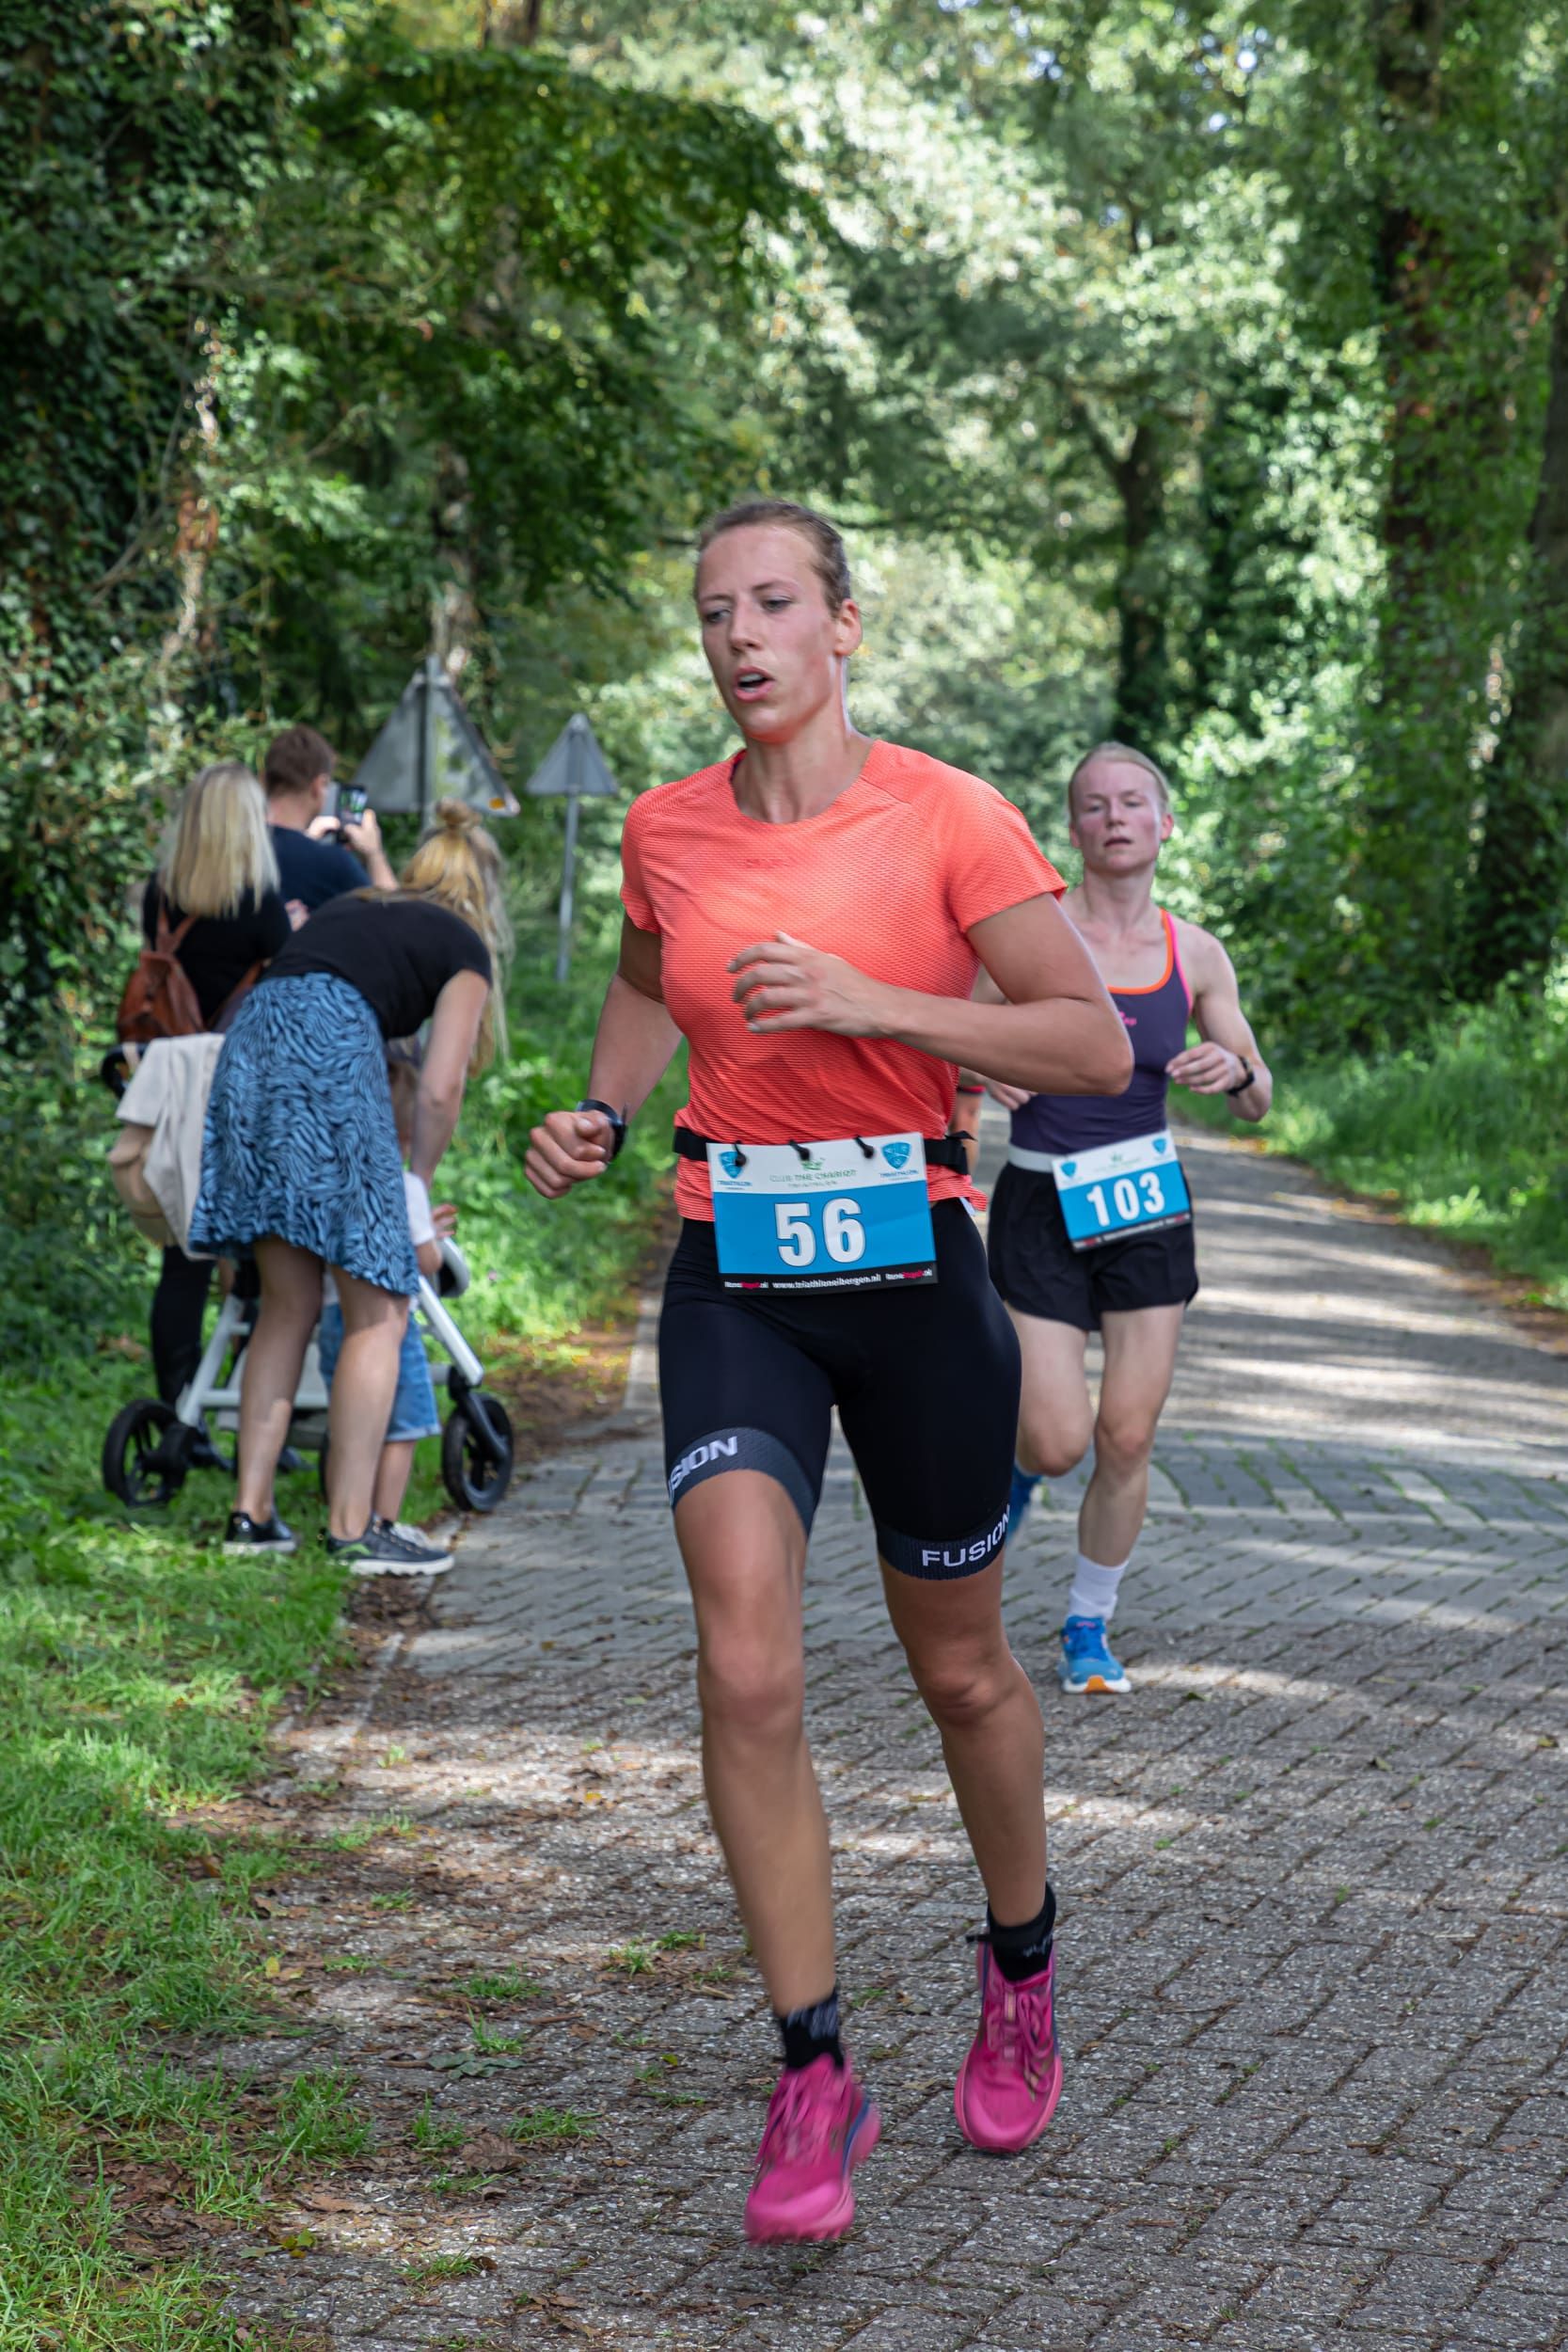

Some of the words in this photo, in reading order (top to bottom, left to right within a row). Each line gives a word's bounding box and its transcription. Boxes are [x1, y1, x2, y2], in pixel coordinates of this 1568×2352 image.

[1085, 1171, 1165, 1227] 103
[775, 1198, 866, 1267] 56
[922, 1503, 1010, 1567] FUSION
